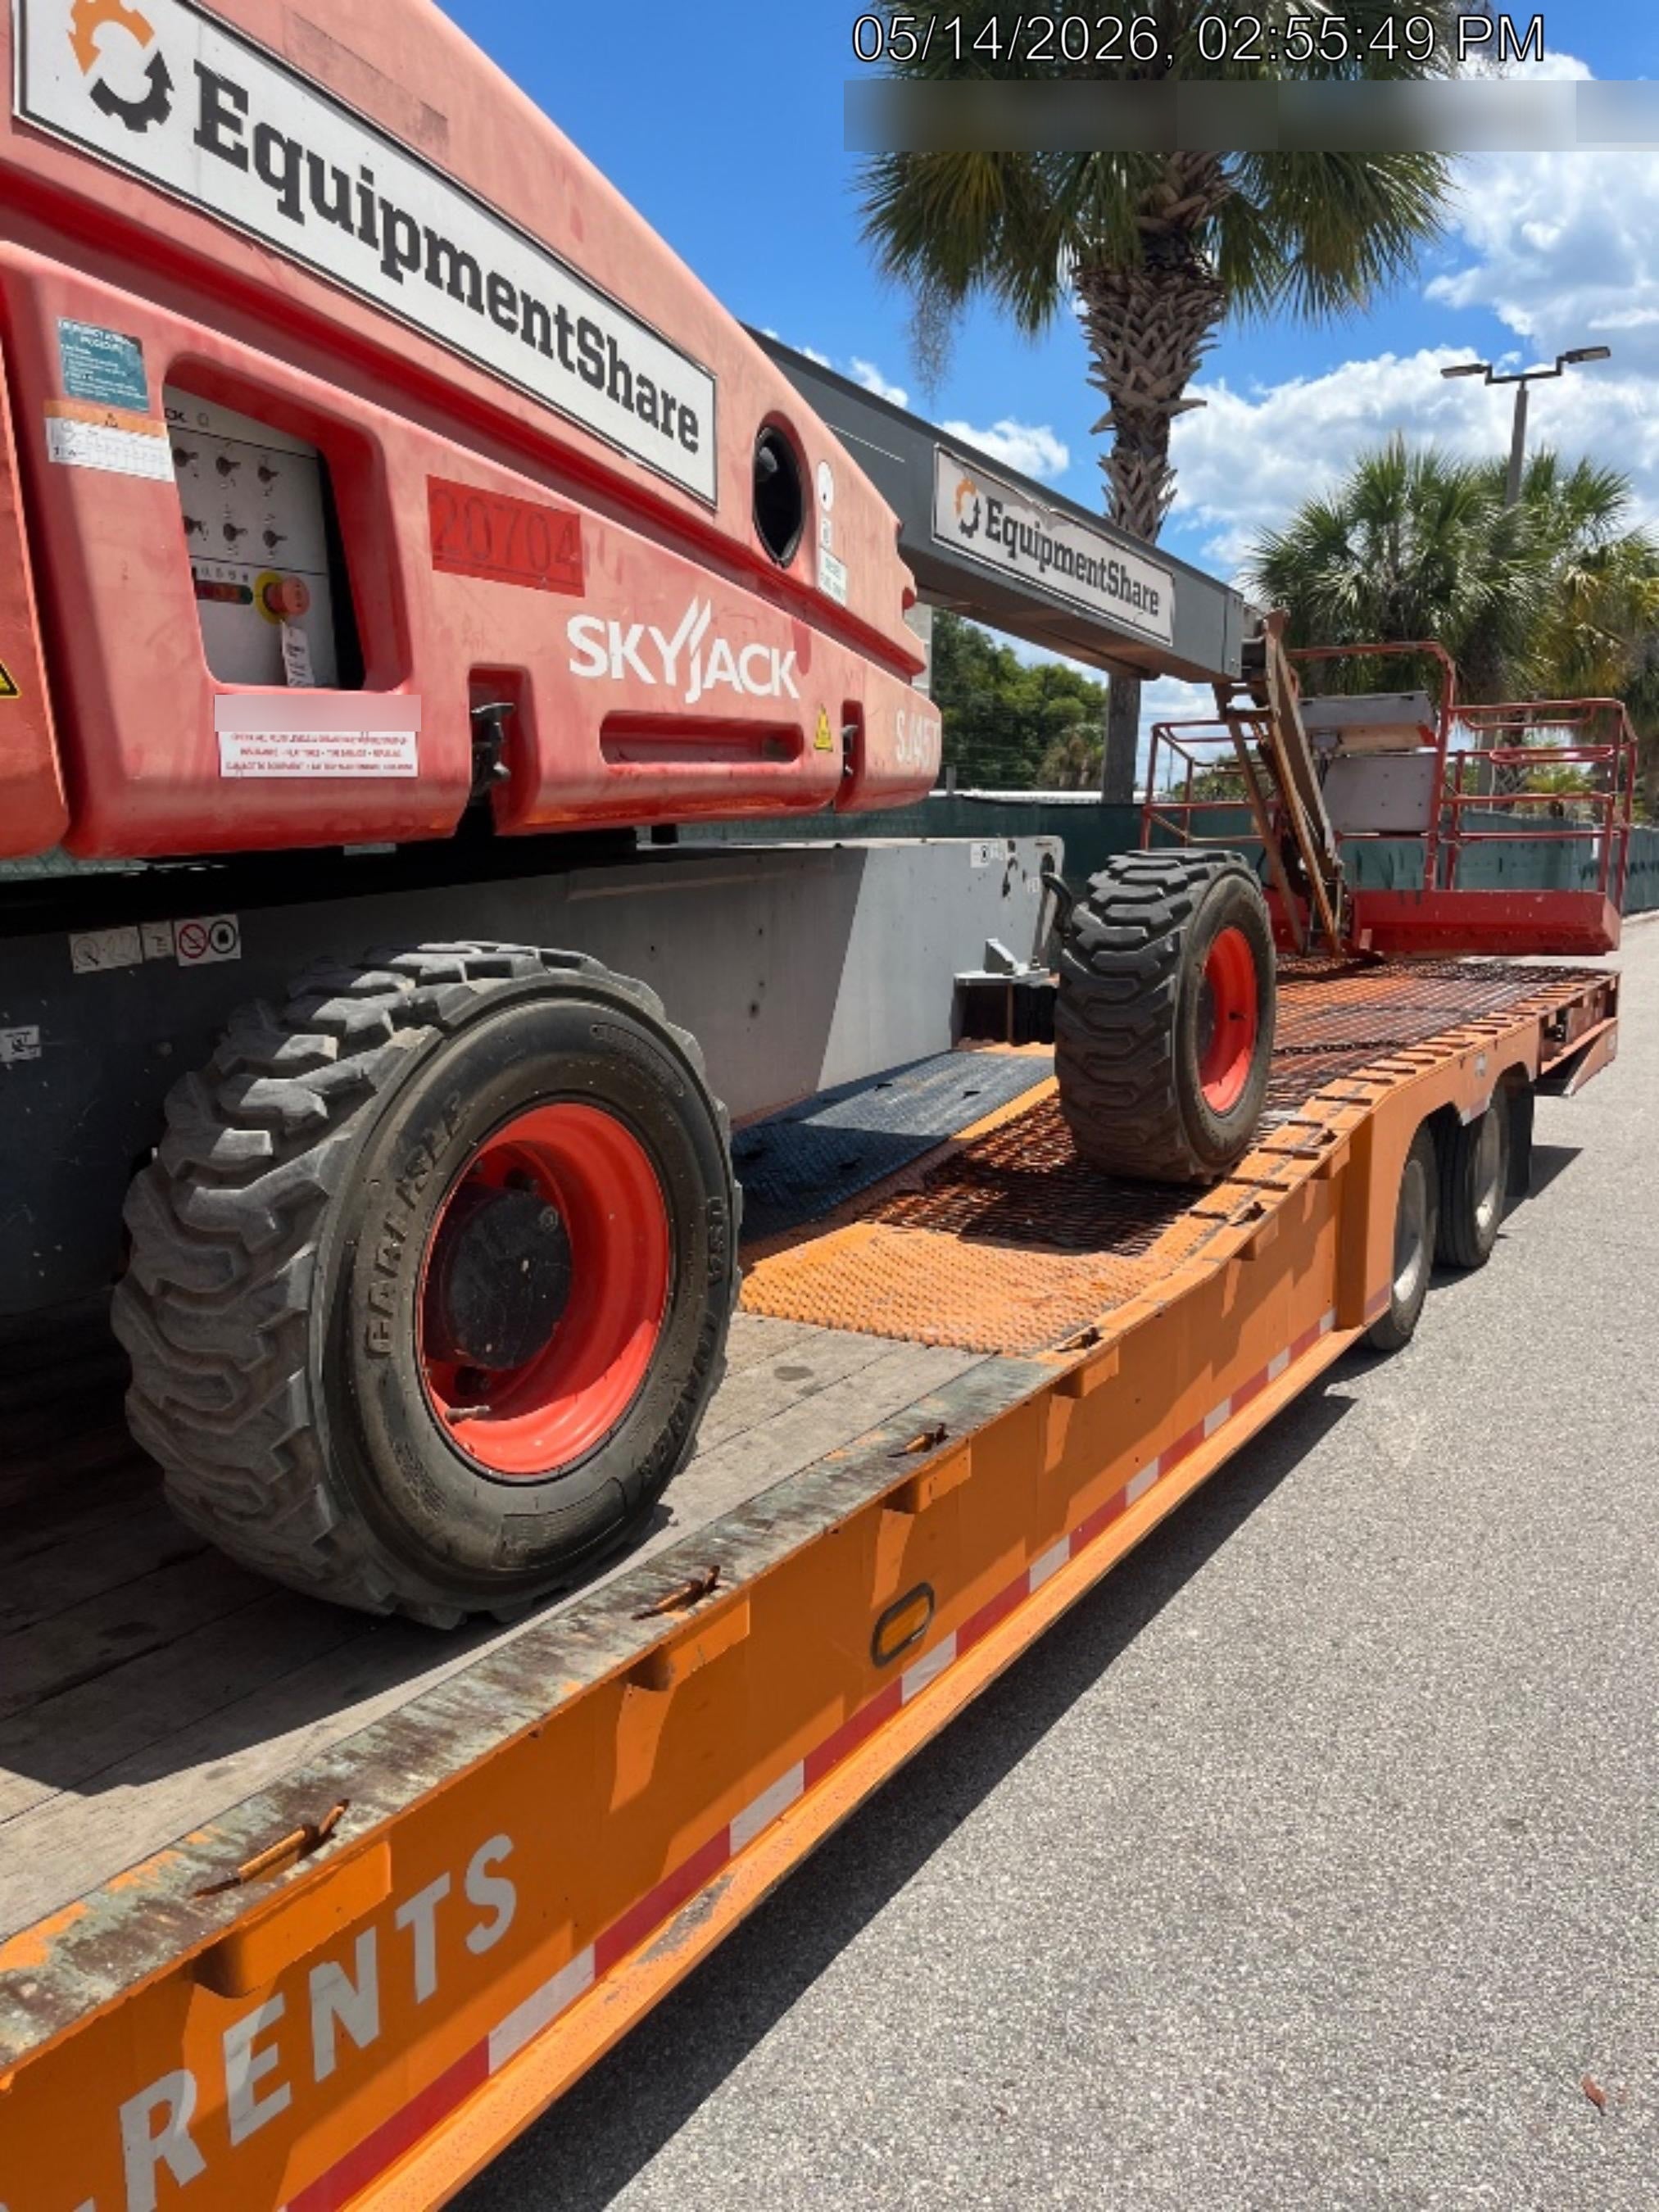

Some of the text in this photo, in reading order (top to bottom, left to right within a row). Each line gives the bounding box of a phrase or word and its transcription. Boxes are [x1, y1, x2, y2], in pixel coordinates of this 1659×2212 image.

[193, 59, 699, 454] EquipmentShare
[430, 489, 582, 573] 20704
[985, 496, 1159, 616] EquipmentShare
[567, 596, 800, 704] SKYJACK
